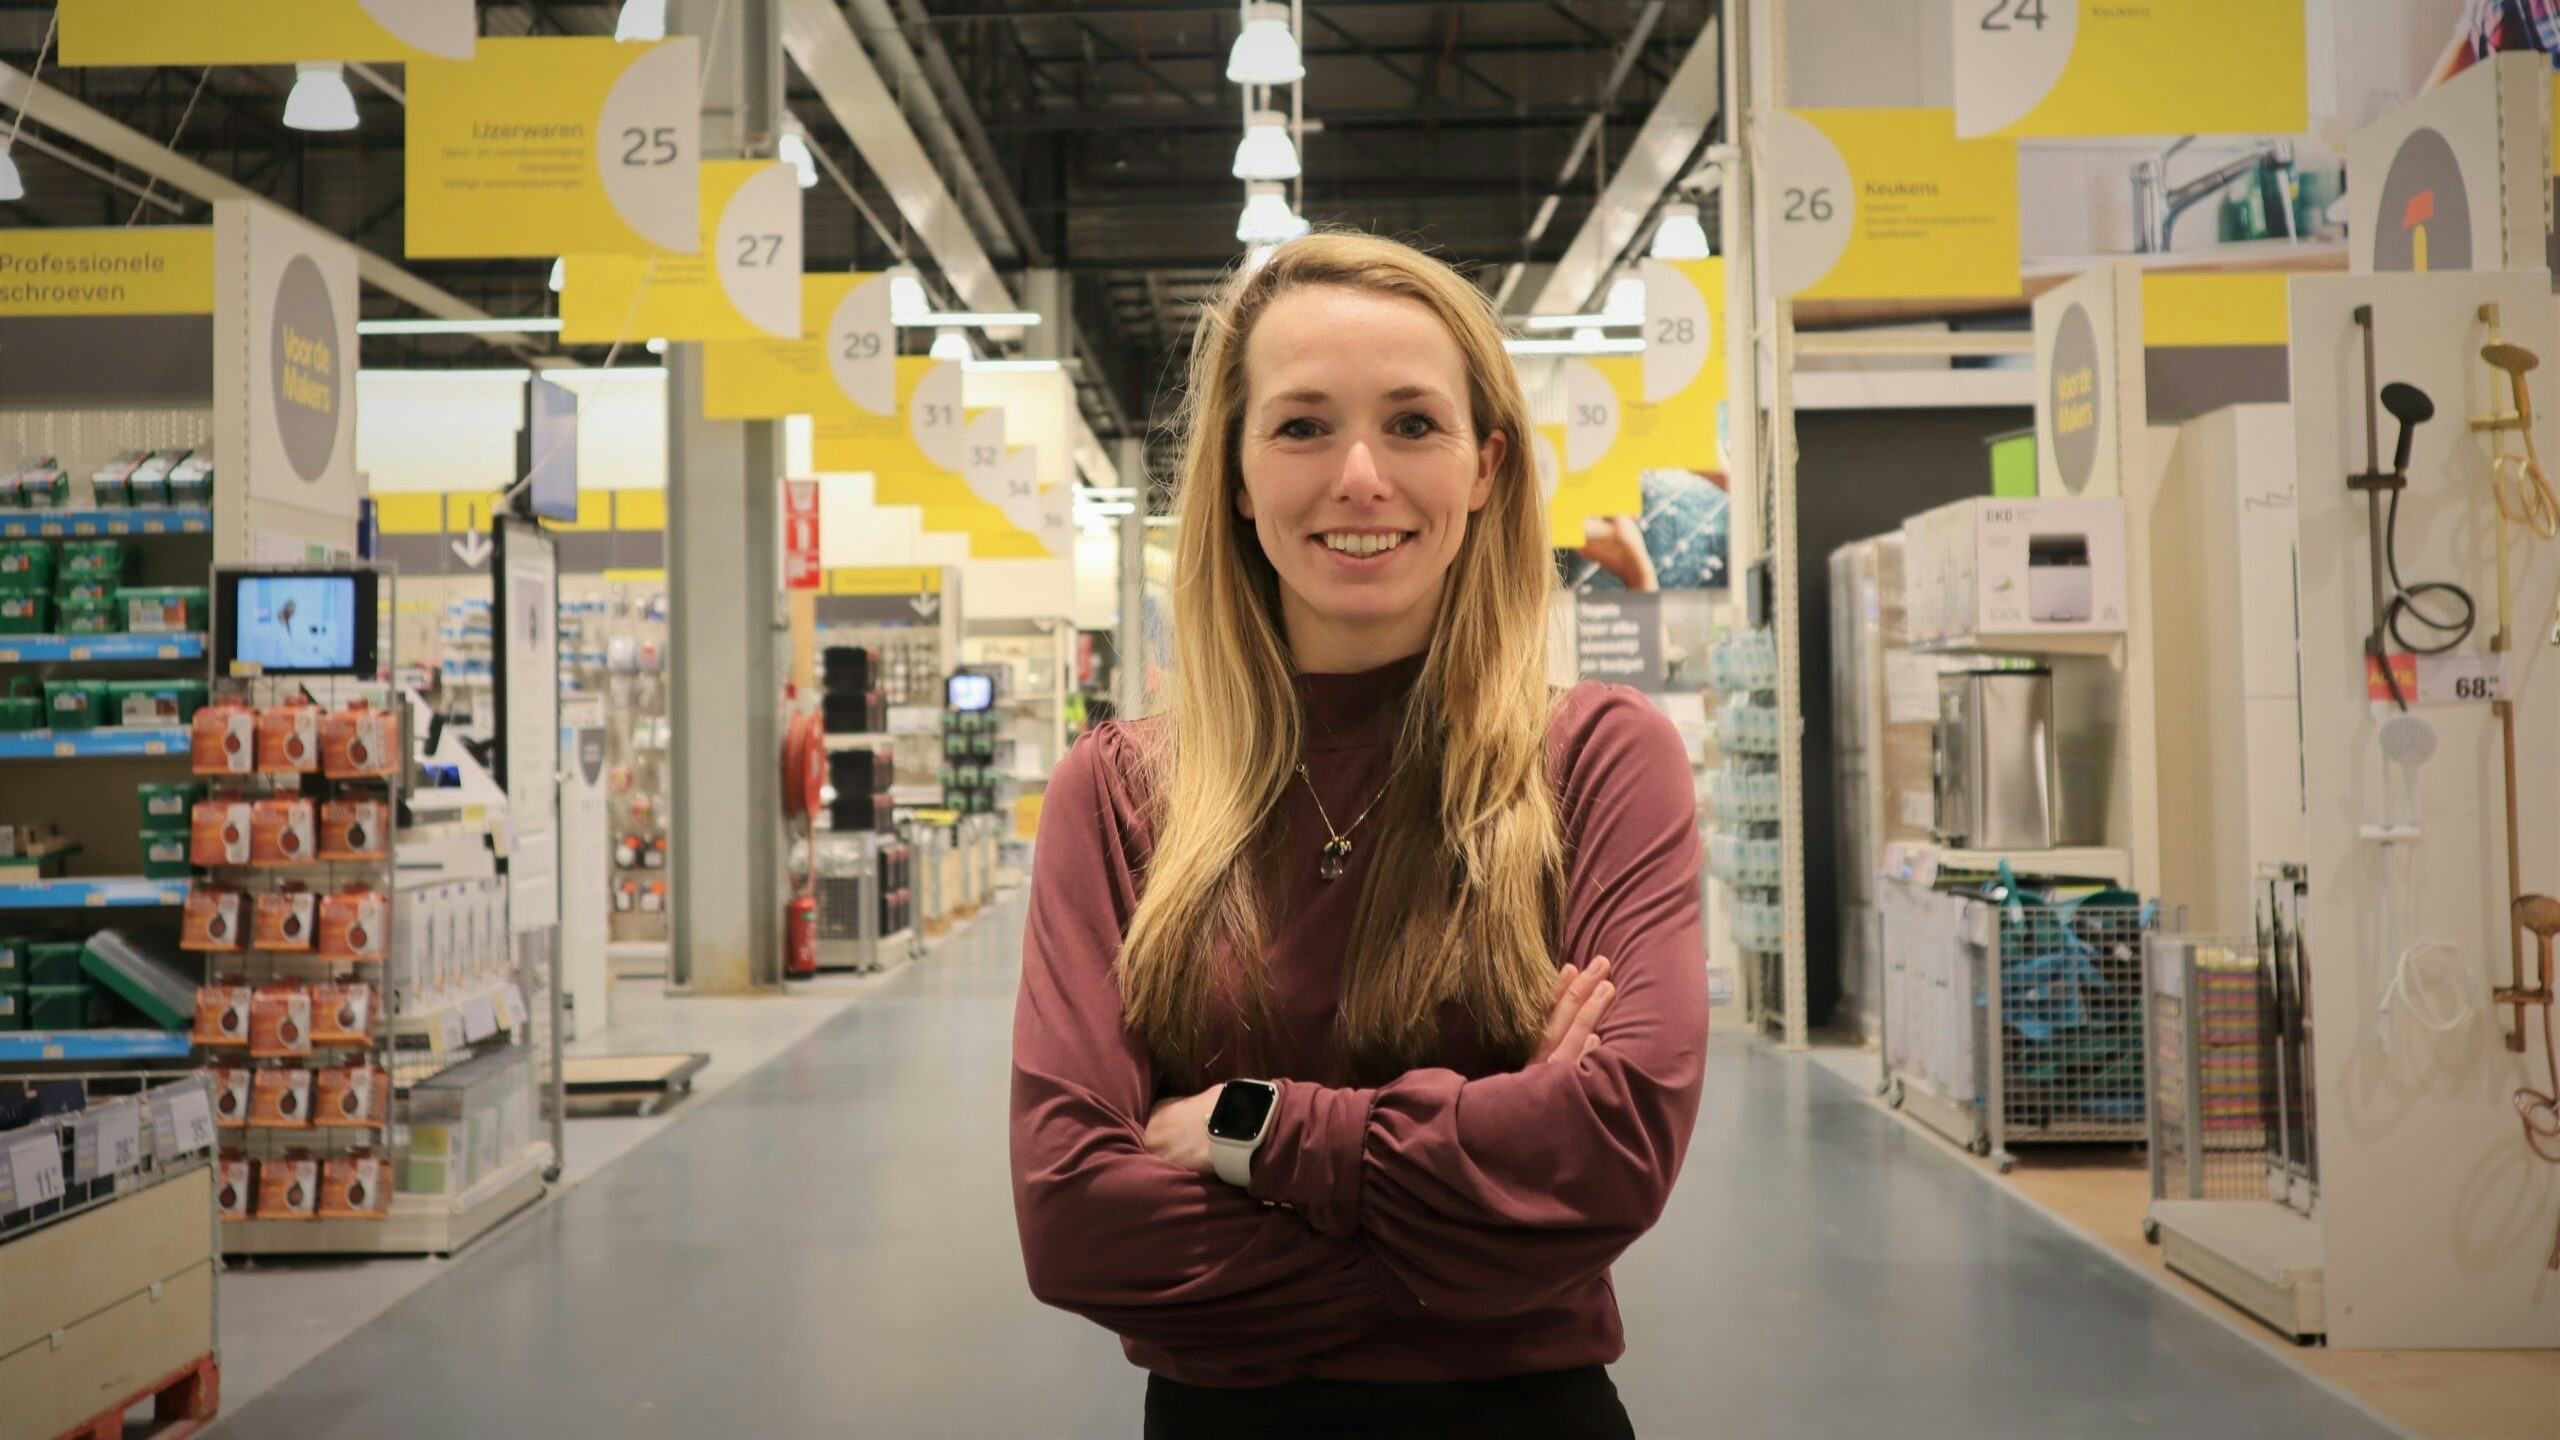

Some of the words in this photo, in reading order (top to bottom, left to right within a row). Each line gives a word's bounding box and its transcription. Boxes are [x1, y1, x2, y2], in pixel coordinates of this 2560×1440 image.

[1981, 0, 2049, 30] 24
[622, 127, 678, 165] 25
[1865, 181, 1939, 197] Keukens
[1784, 188, 1834, 222] 26
[0, 252, 165, 273] Professionele
[737, 235, 783, 267] 27
[0, 281, 125, 302] schroeven
[1657, 318, 1695, 344] 28
[844, 332, 880, 359] 29
[924, 404, 953, 428] 31
[1576, 403, 1607, 426] 30
[972, 446, 998, 467] 32
[1007, 479, 1031, 498] 34
